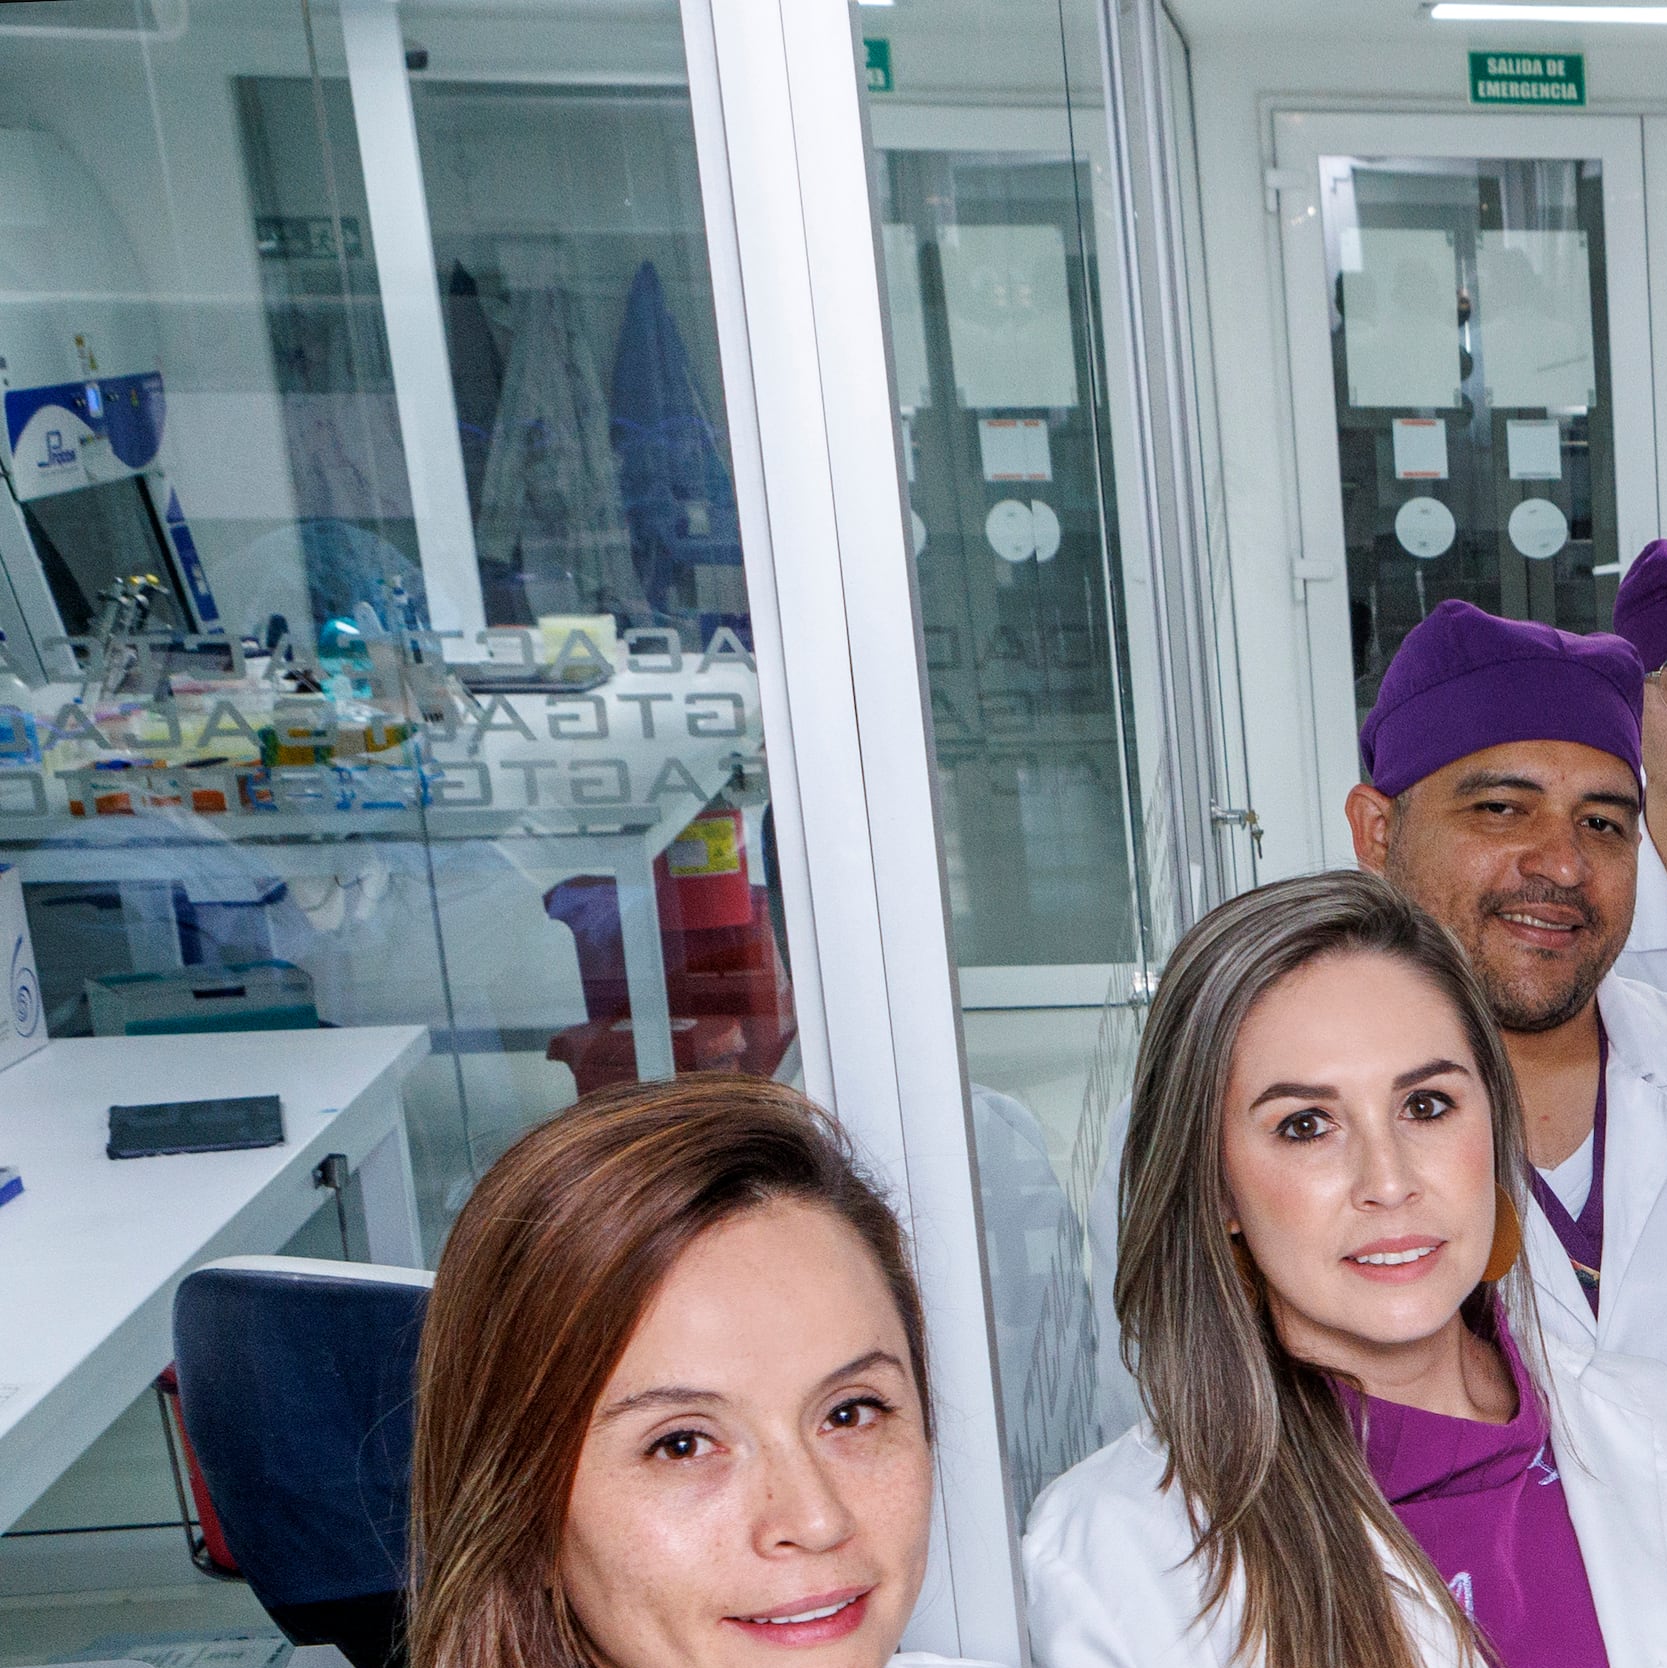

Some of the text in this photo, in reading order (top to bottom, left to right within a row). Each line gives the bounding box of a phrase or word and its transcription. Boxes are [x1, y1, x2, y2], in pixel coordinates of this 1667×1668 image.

[1487, 57, 1565, 76] SALIDA DE
[1478, 80, 1578, 99] EMERGENCIA
